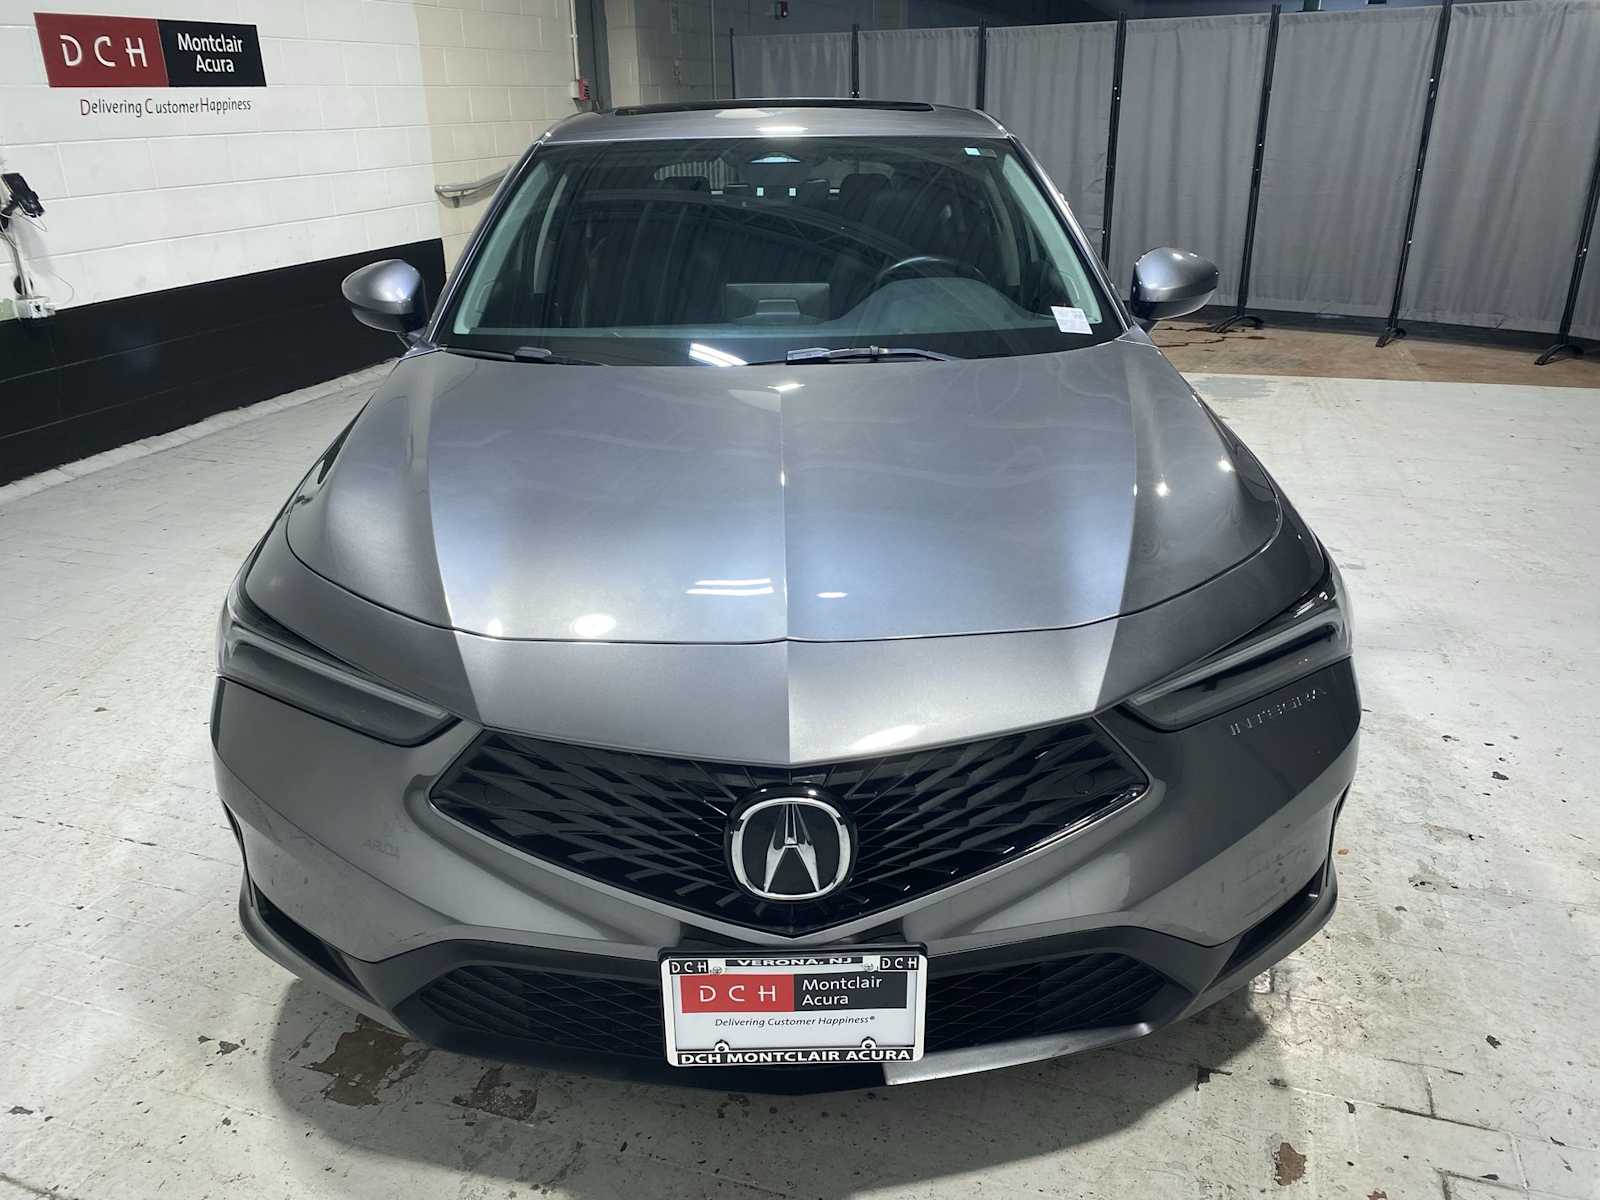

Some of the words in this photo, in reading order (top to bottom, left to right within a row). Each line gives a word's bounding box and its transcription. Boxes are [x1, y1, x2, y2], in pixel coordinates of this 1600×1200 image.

[177, 32, 243, 53] Montclair
[59, 34, 149, 68] DCH
[196, 54, 235, 73] Acura
[80, 99, 142, 118] Delivering
[144, 98, 199, 115] Customer
[200, 97, 252, 115] Happiness
[671, 961, 707, 973] DCH
[881, 957, 918, 969] DCH
[802, 975, 883, 991] Montclair
[699, 985, 776, 1003] DCH
[801, 994, 849, 1006] Acura
[715, 1018, 765, 1028] Delivering
[767, 1017, 815, 1026] Customer
[681, 1053, 721, 1064] DCH
[726, 1051, 841, 1063] MONTCLAIR
[845, 1049, 911, 1061] ACURA
